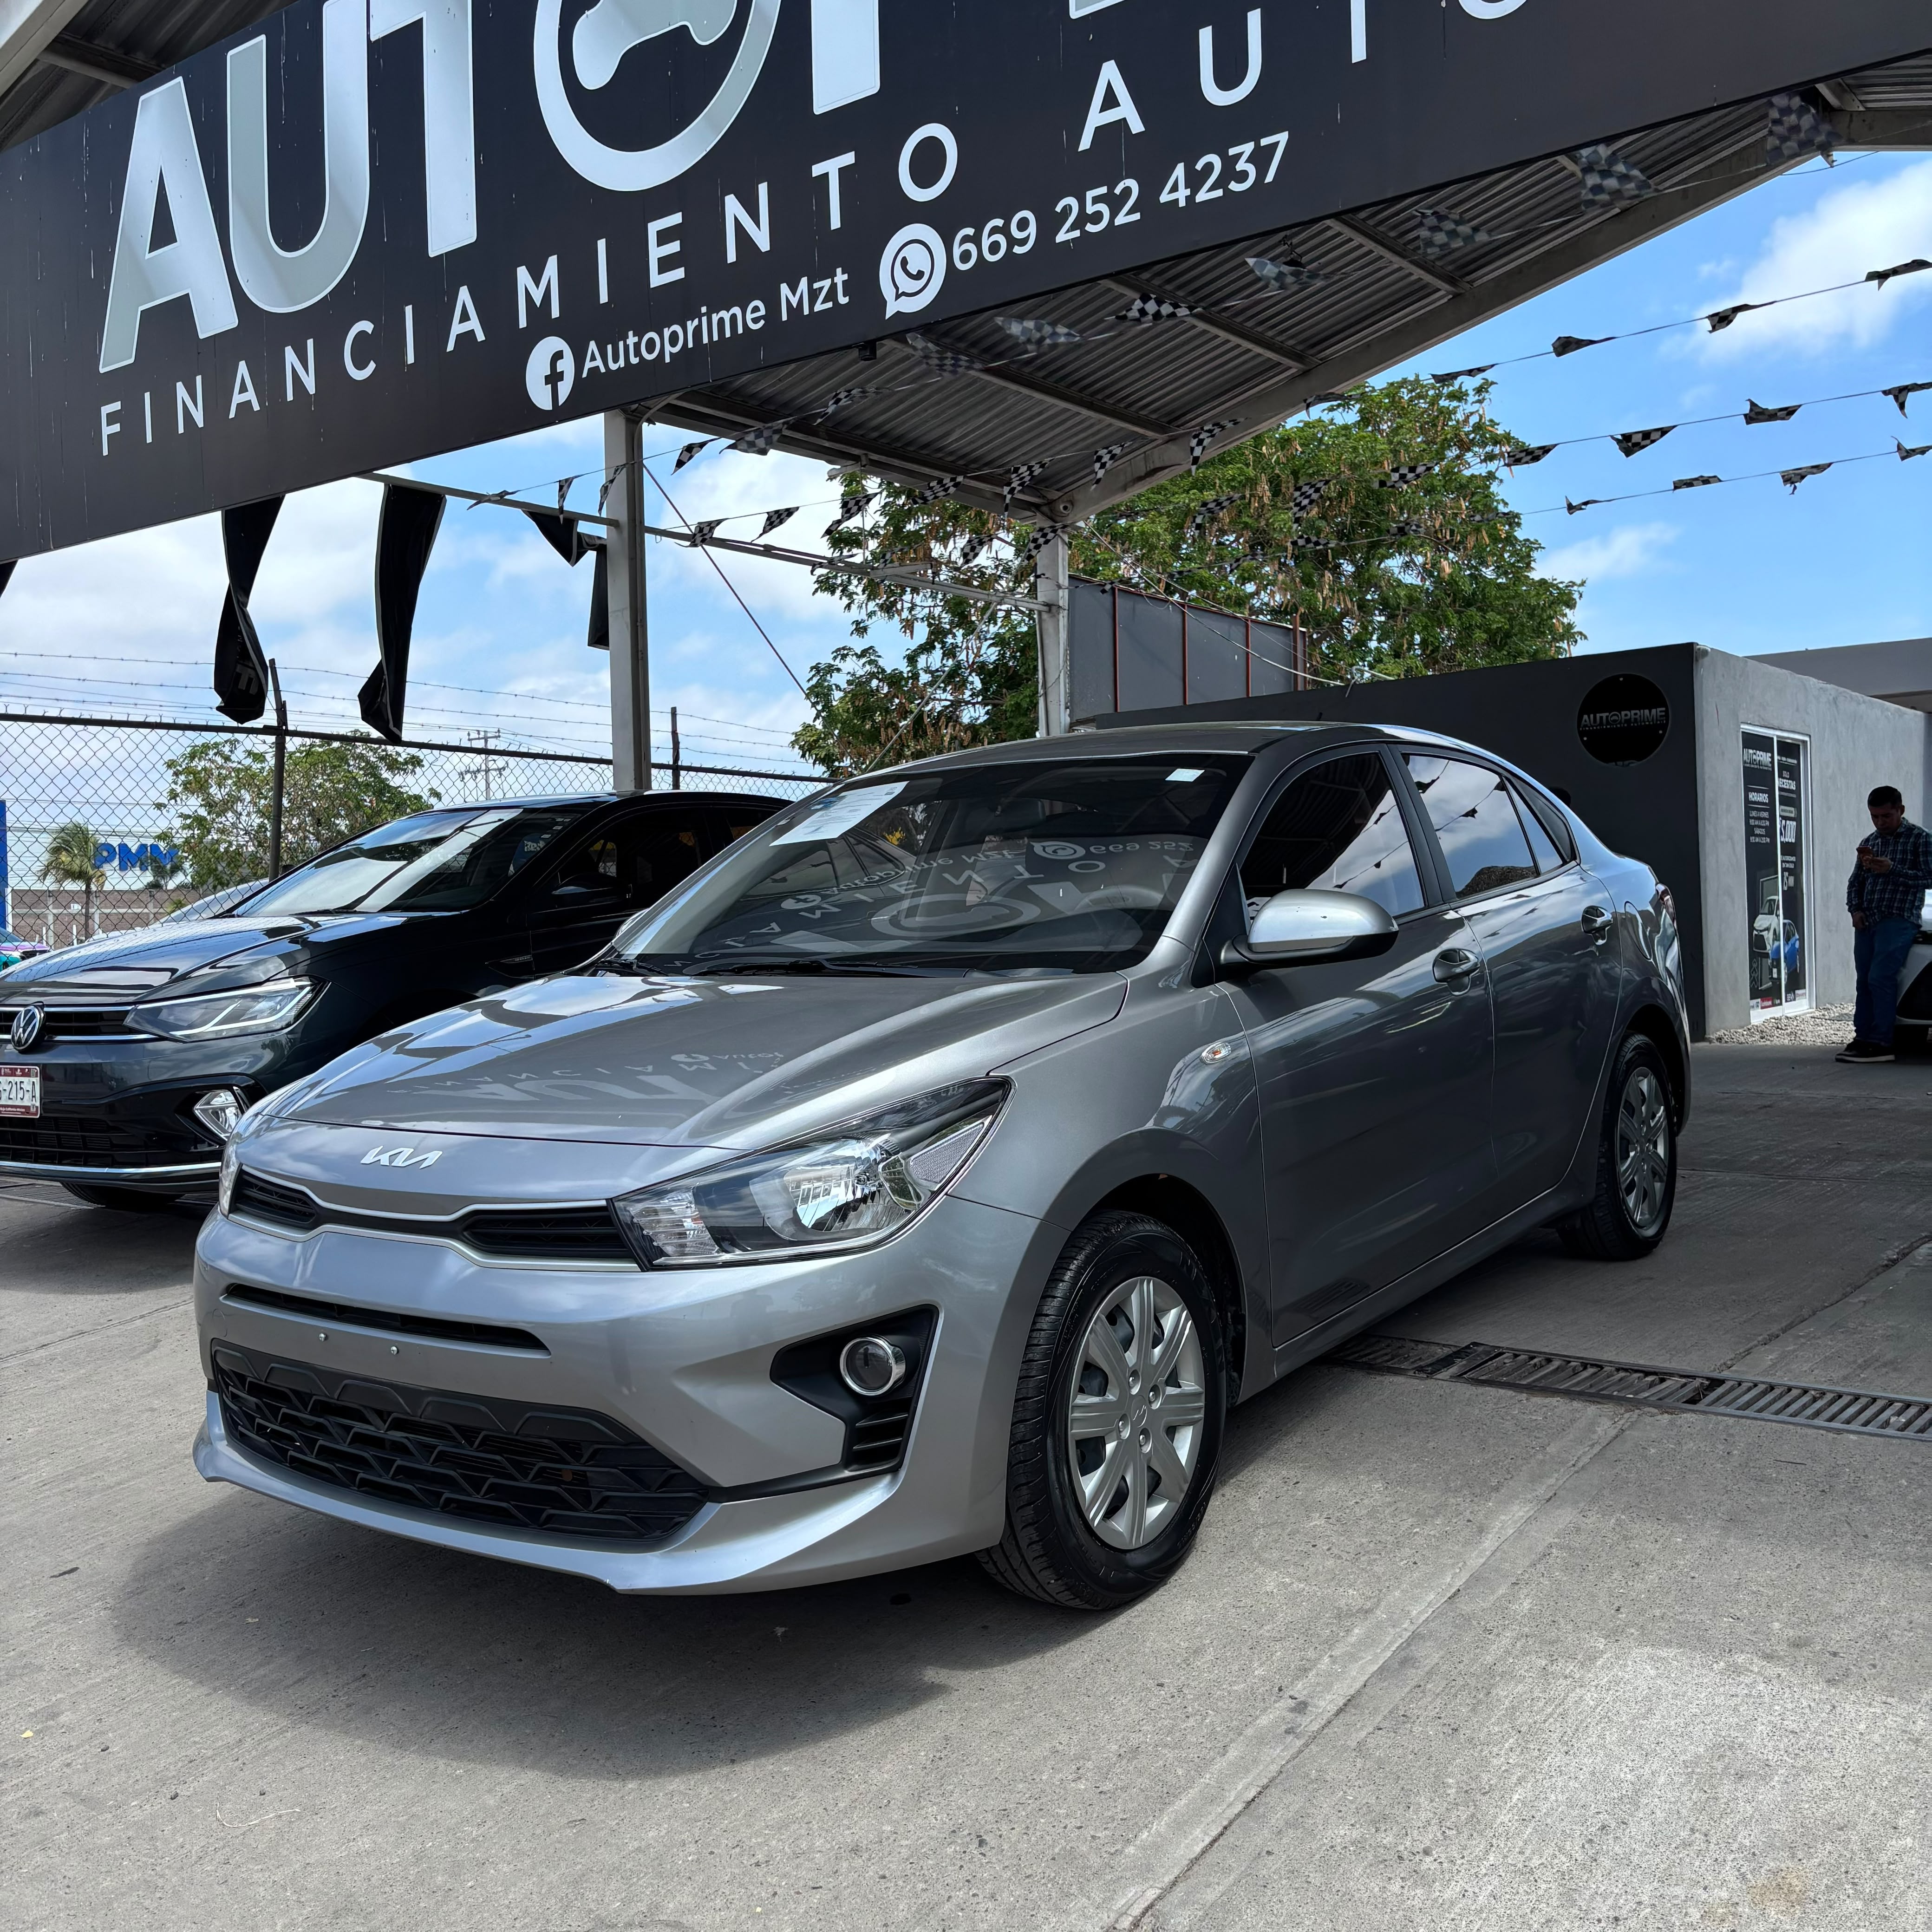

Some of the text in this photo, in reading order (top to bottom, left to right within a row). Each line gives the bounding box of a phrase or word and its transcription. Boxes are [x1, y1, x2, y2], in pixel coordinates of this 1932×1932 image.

[952, 131, 1289, 271] 669 252 4237
[101, 123, 958, 457] FINANCIAMIENTO
[581, 267, 850, 378] Autoprime Mzt
[1581, 707, 1666, 727] AUTOPRIME
[1743, 748, 1772, 767] AUTOPRIME
[1749, 792, 1769, 803] HORARIOS
[360, 1145, 443, 1169] KIA
